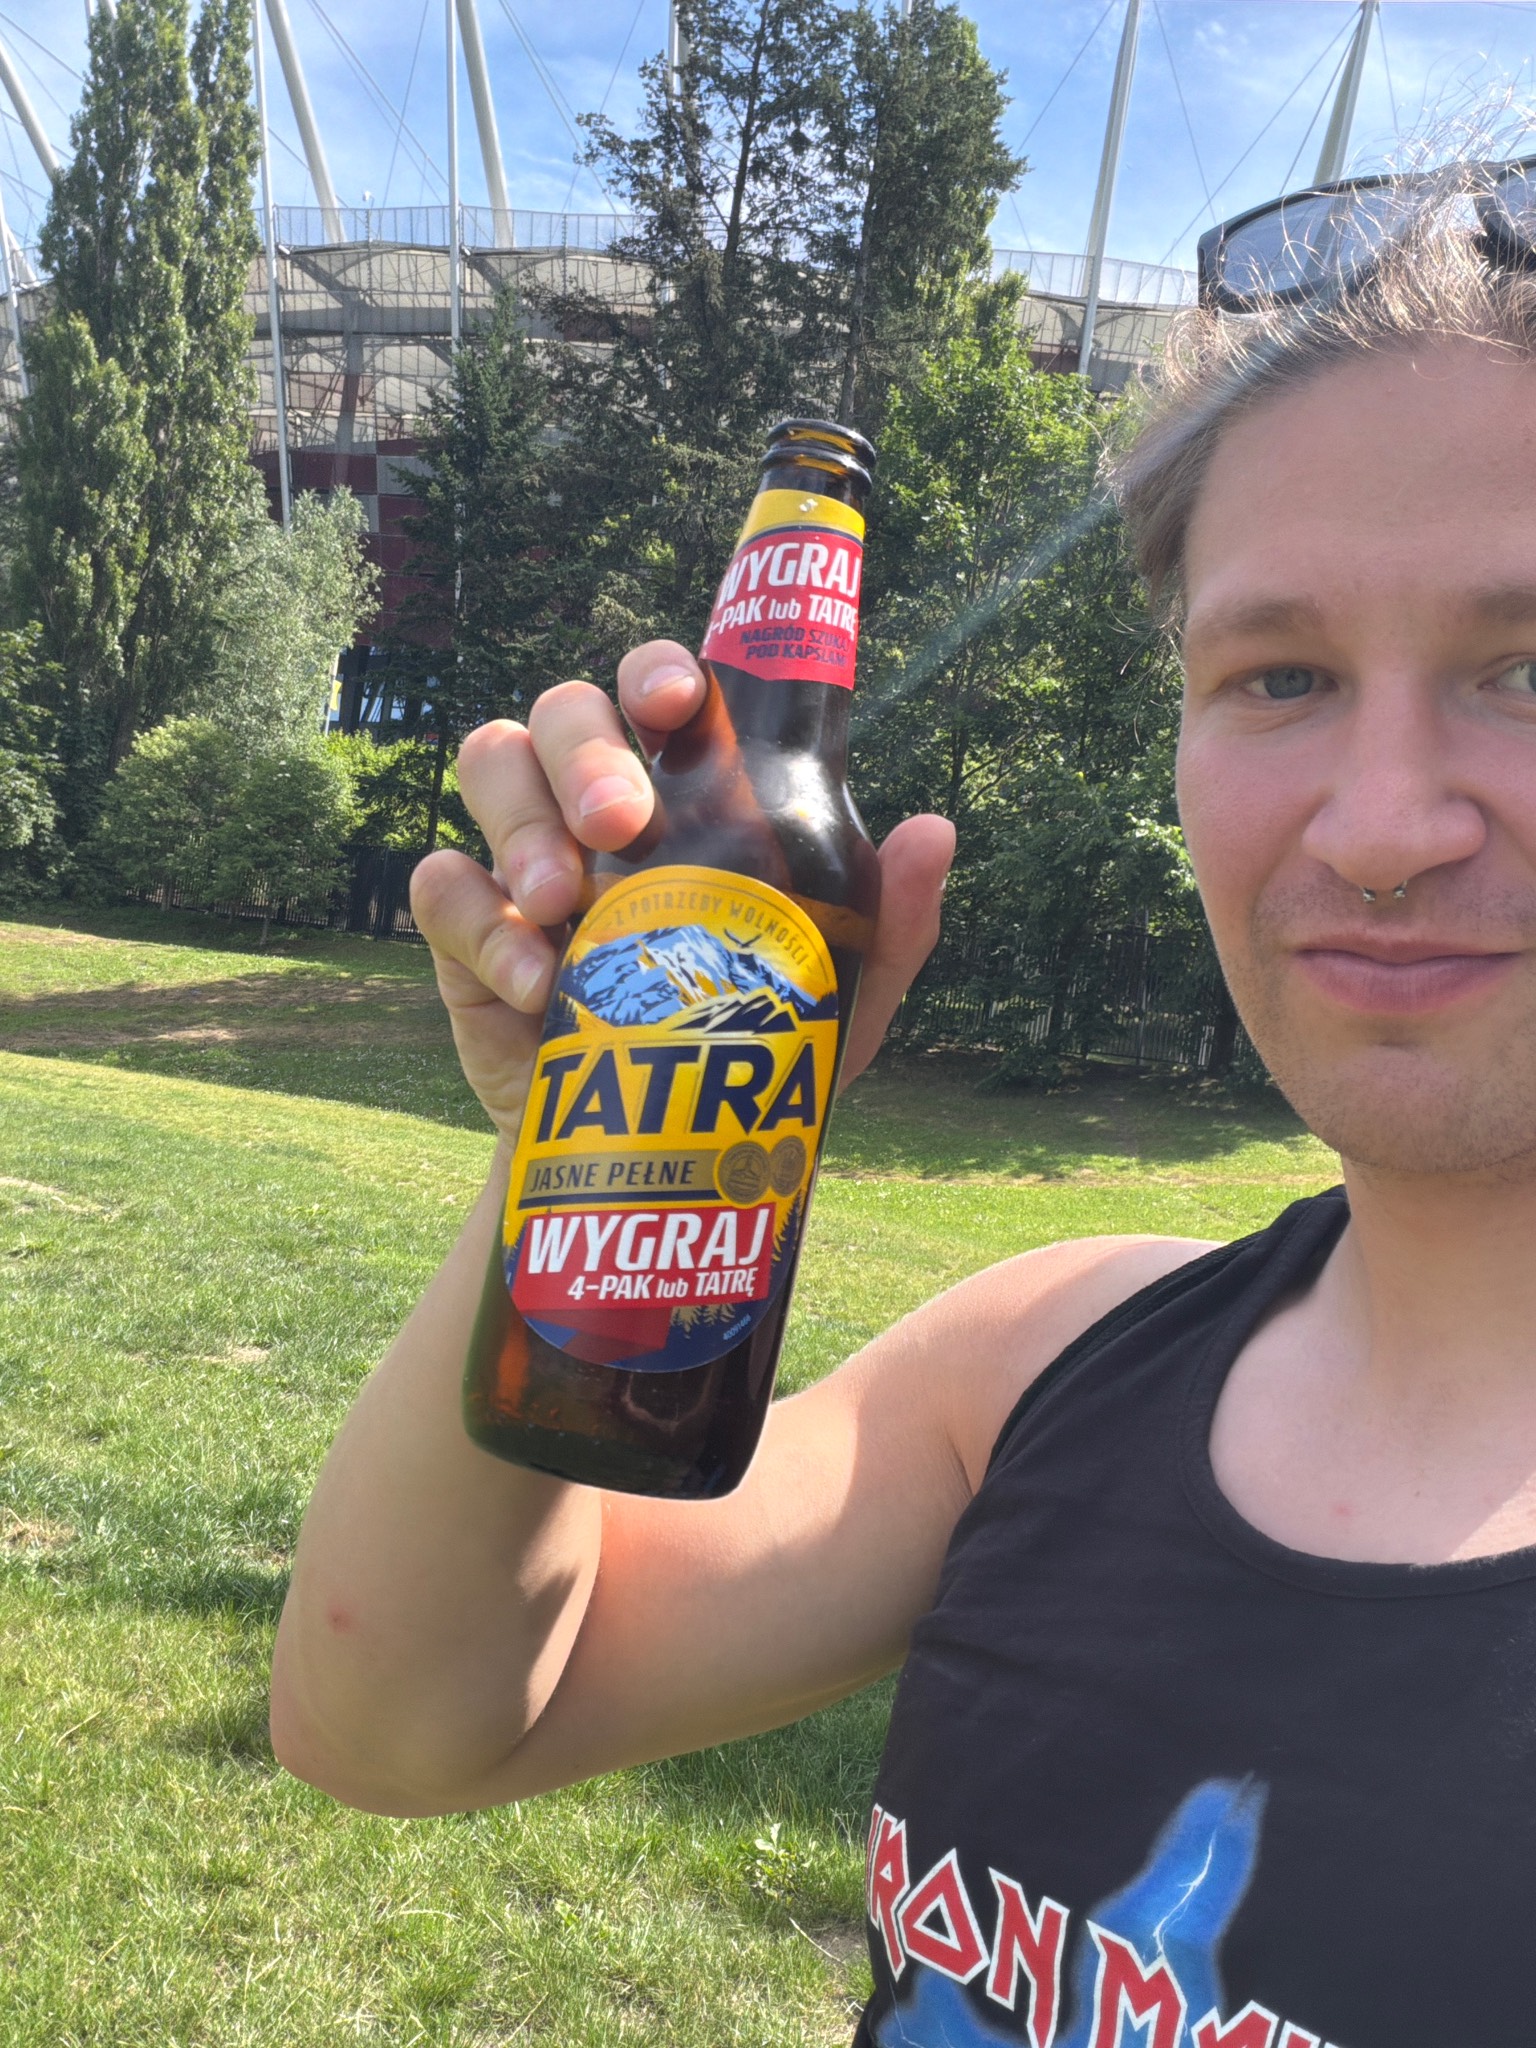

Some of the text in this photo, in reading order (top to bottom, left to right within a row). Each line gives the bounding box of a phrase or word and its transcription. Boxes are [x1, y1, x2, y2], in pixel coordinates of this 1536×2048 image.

[718, 542, 861, 610] WYGRAJ
[769, 598, 801, 621] lub
[741, 625, 806, 644] NAGRÓD
[746, 644, 779, 660] POD
[615, 891, 810, 966] Z POTRZEBY WOLNOŚCI
[536, 1043, 817, 1143] TATRA
[530, 1162, 600, 1193] JASNE
[607, 1160, 697, 1187] PEŁNE
[527, 1209, 770, 1274] WYGRAJ
[567, 1267, 758, 1301] 4-PAK lub TATRĘ
